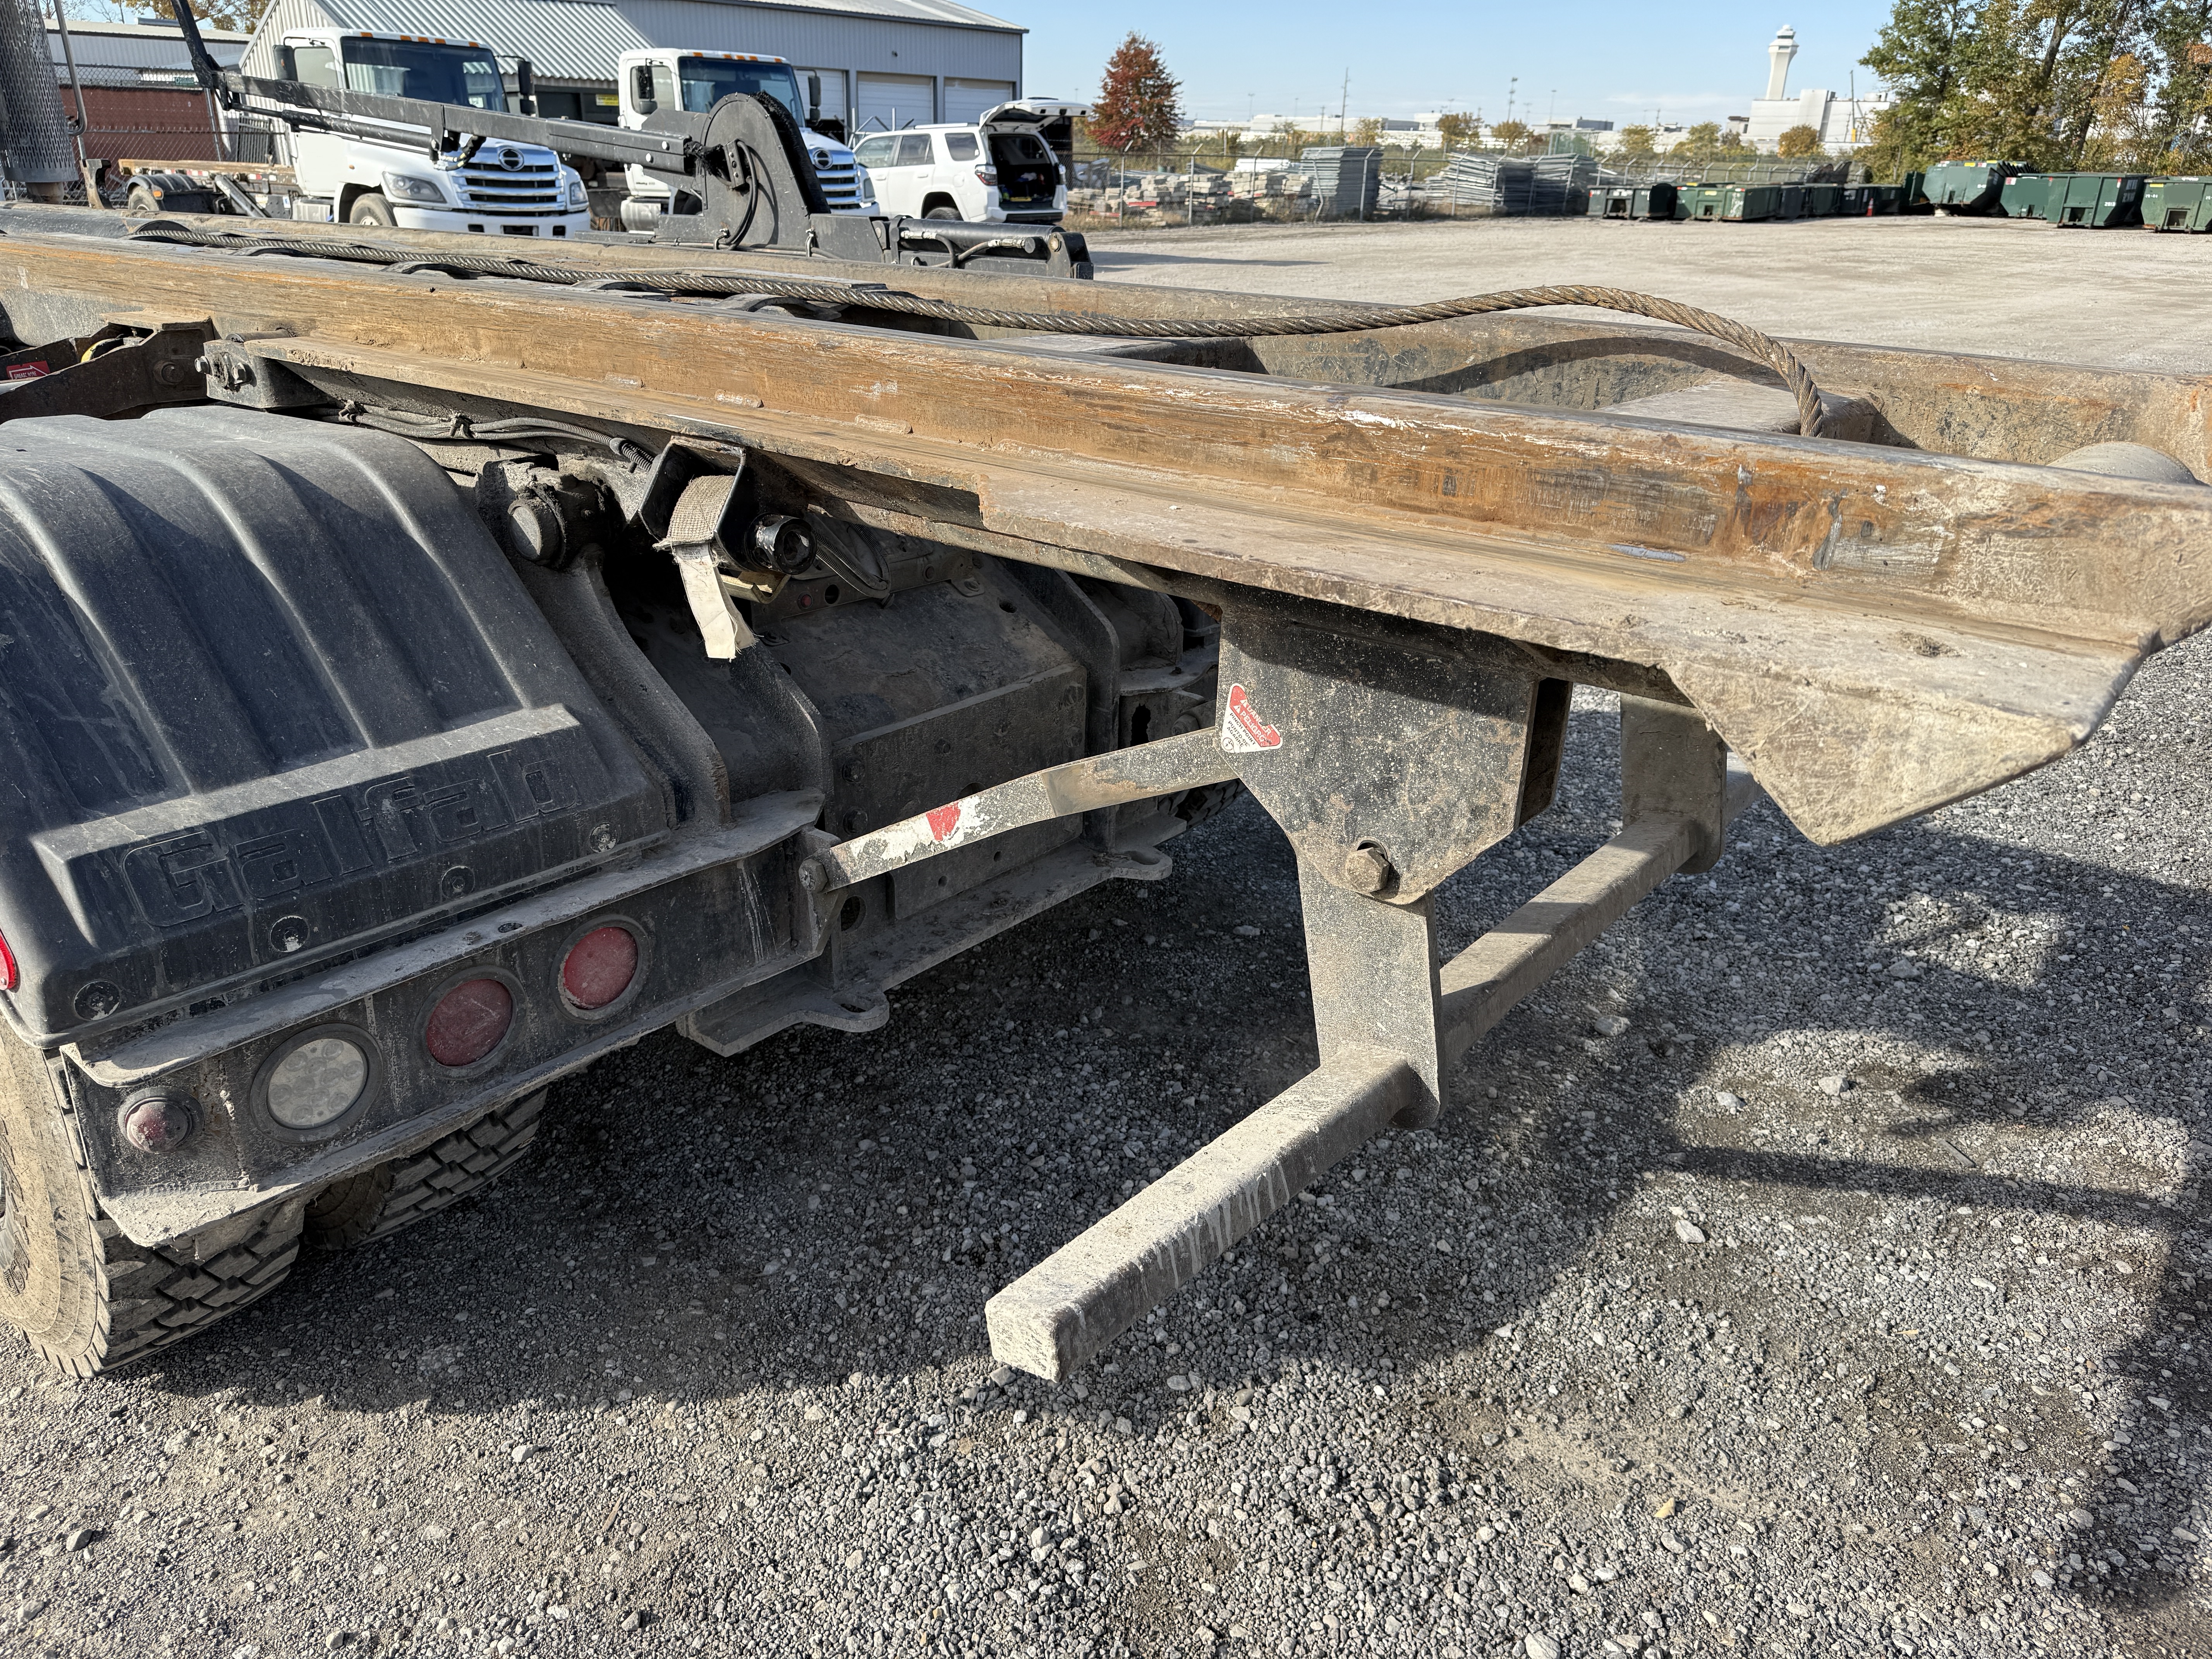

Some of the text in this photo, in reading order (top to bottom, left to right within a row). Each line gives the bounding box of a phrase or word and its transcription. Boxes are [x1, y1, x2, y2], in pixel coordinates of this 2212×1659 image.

[1228, 720, 1243, 739] PUNTO
[1230, 713, 1256, 745] PINCH POINT
[122, 749, 577, 927] Galfab
